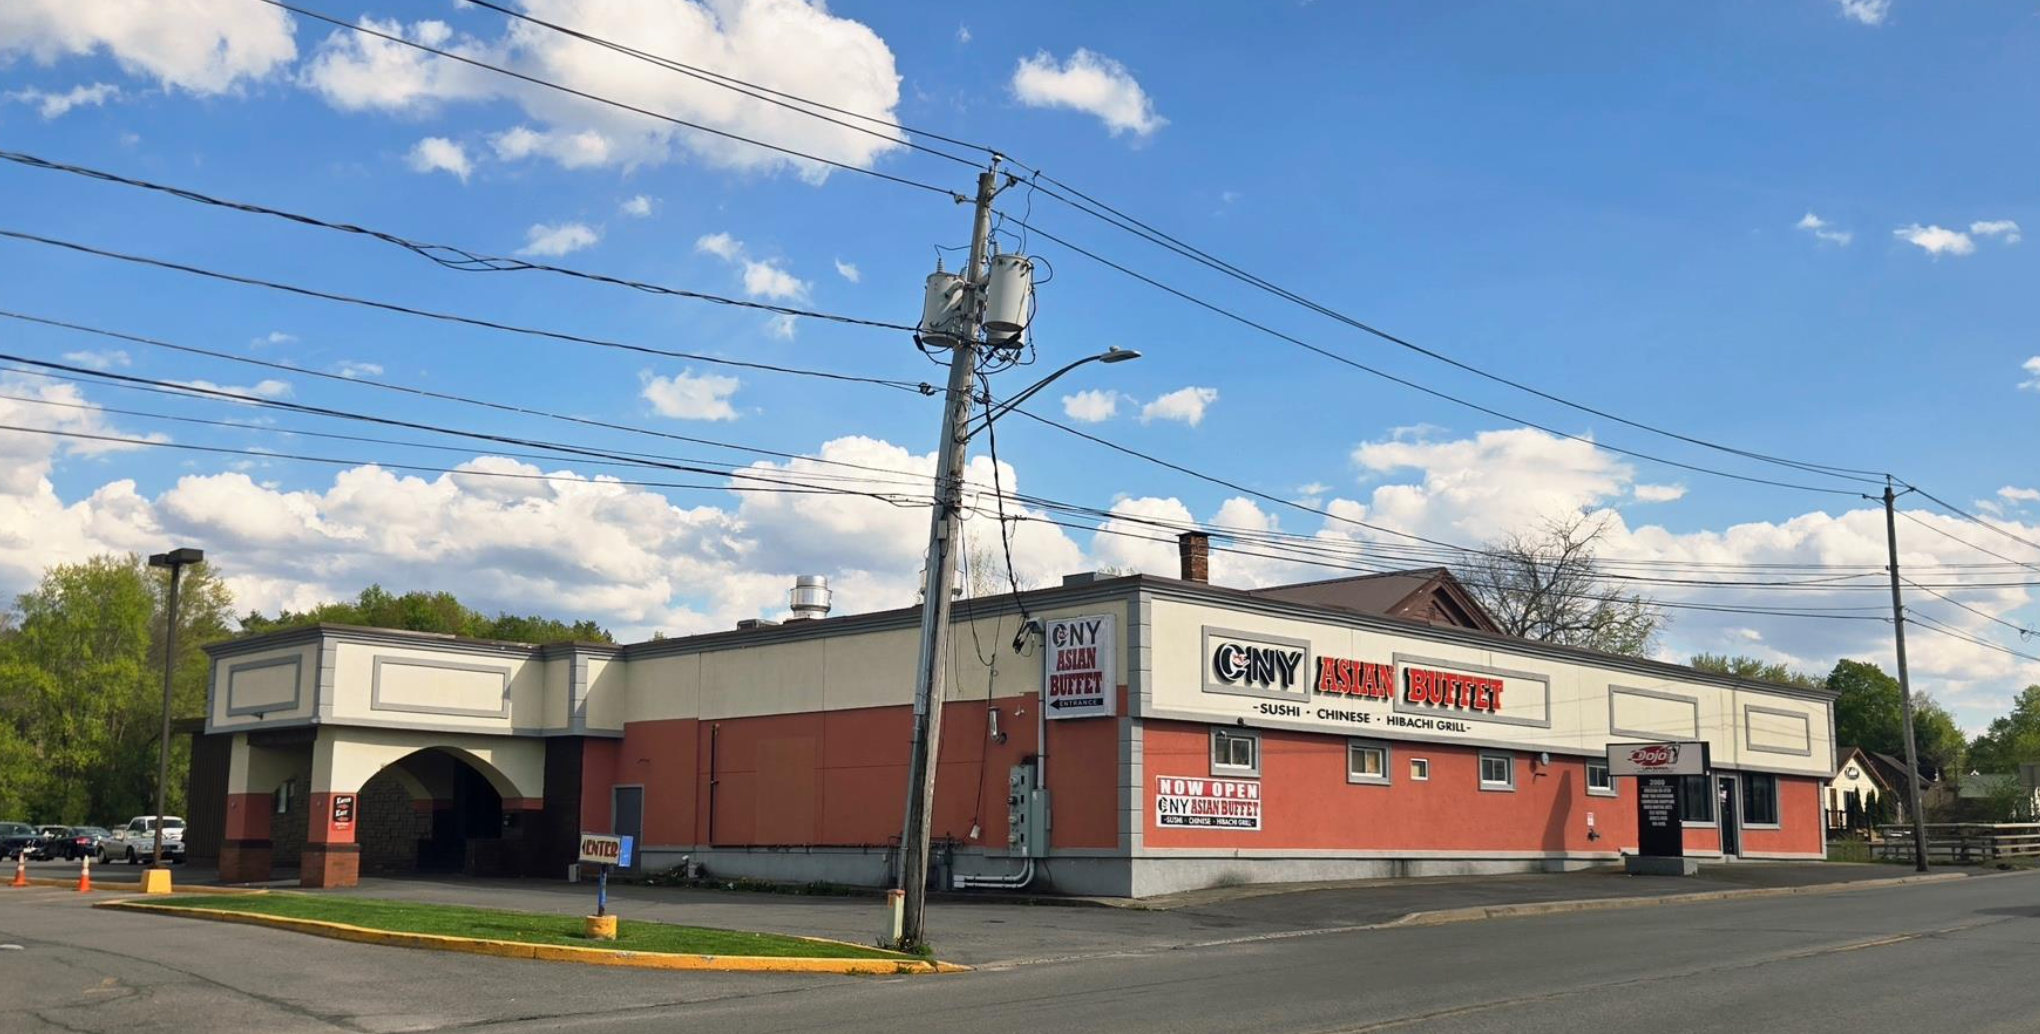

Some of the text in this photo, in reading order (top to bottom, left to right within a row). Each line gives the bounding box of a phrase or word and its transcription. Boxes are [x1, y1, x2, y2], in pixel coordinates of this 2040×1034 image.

[1052, 620, 1101, 647] CNY
[1056, 647, 1096, 671] ASIAN
[1049, 671, 1102, 696] BUFFET
[1214, 643, 1503, 711] CNY ASIAN BUFFET
[1059, 699, 1097, 707] ENTRANCE
[1317, 708, 1370, 723] CHINESE
[1387, 716, 1434, 730] HIBACHI
[1632, 749, 1667, 763] Dojo
[1160, 779, 1258, 798] NOW OPEN
[1158, 797, 1258, 816] CNY ASIAN BUFFET
[586, 840, 618, 857] ENTER
